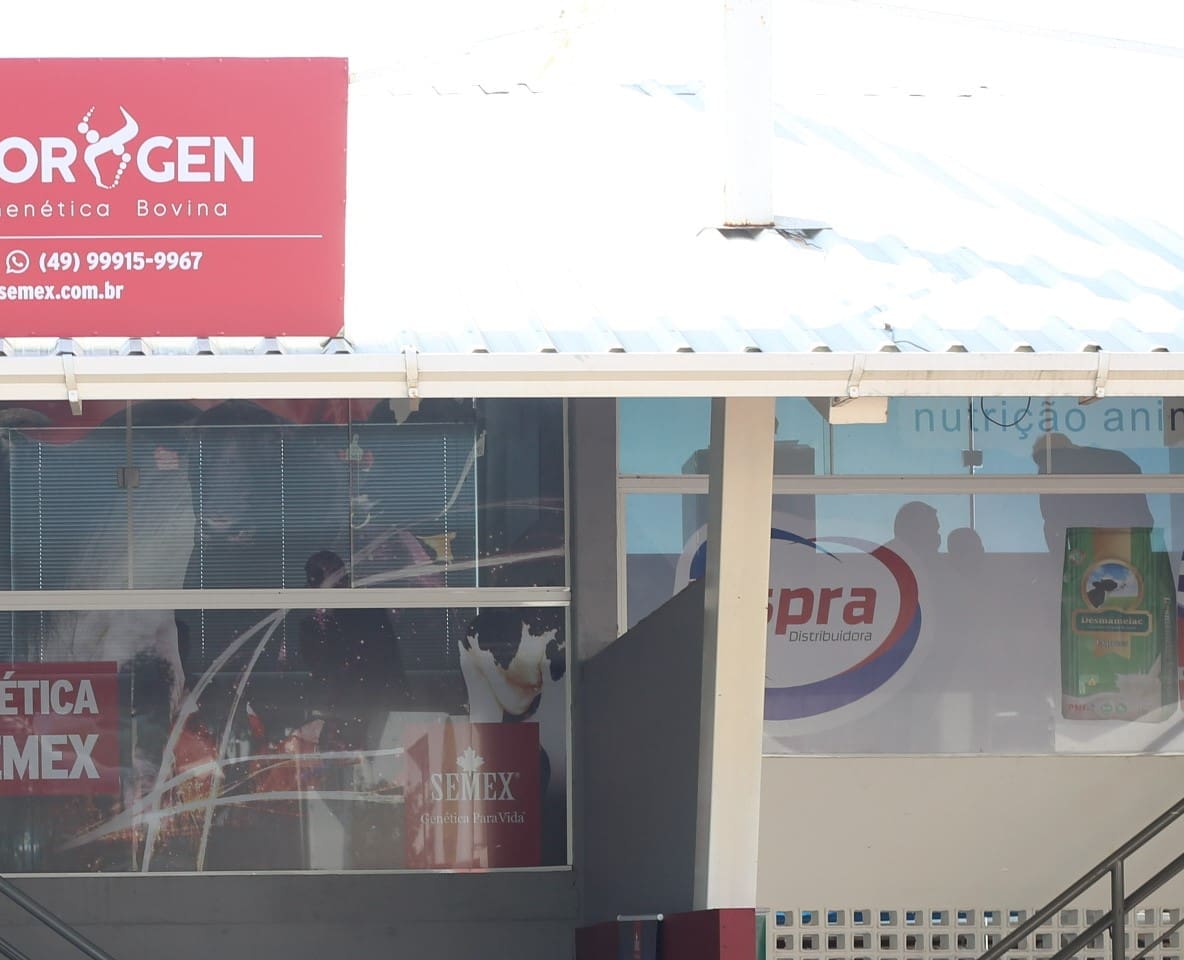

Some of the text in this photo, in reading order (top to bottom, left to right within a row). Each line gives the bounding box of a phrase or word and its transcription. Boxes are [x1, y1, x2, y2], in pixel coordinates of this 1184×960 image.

[136, 199, 229, 217] Bovina
[39, 250, 204, 273] (49) 99915-9967
[914, 400, 1087, 440] nutrição
[767, 587, 877, 635] pra
[789, 630, 873, 642] Distribuidora
[431, 771, 516, 801] SEMEX
[420, 812, 469, 825] Genética
[473, 812, 497, 824] Para
